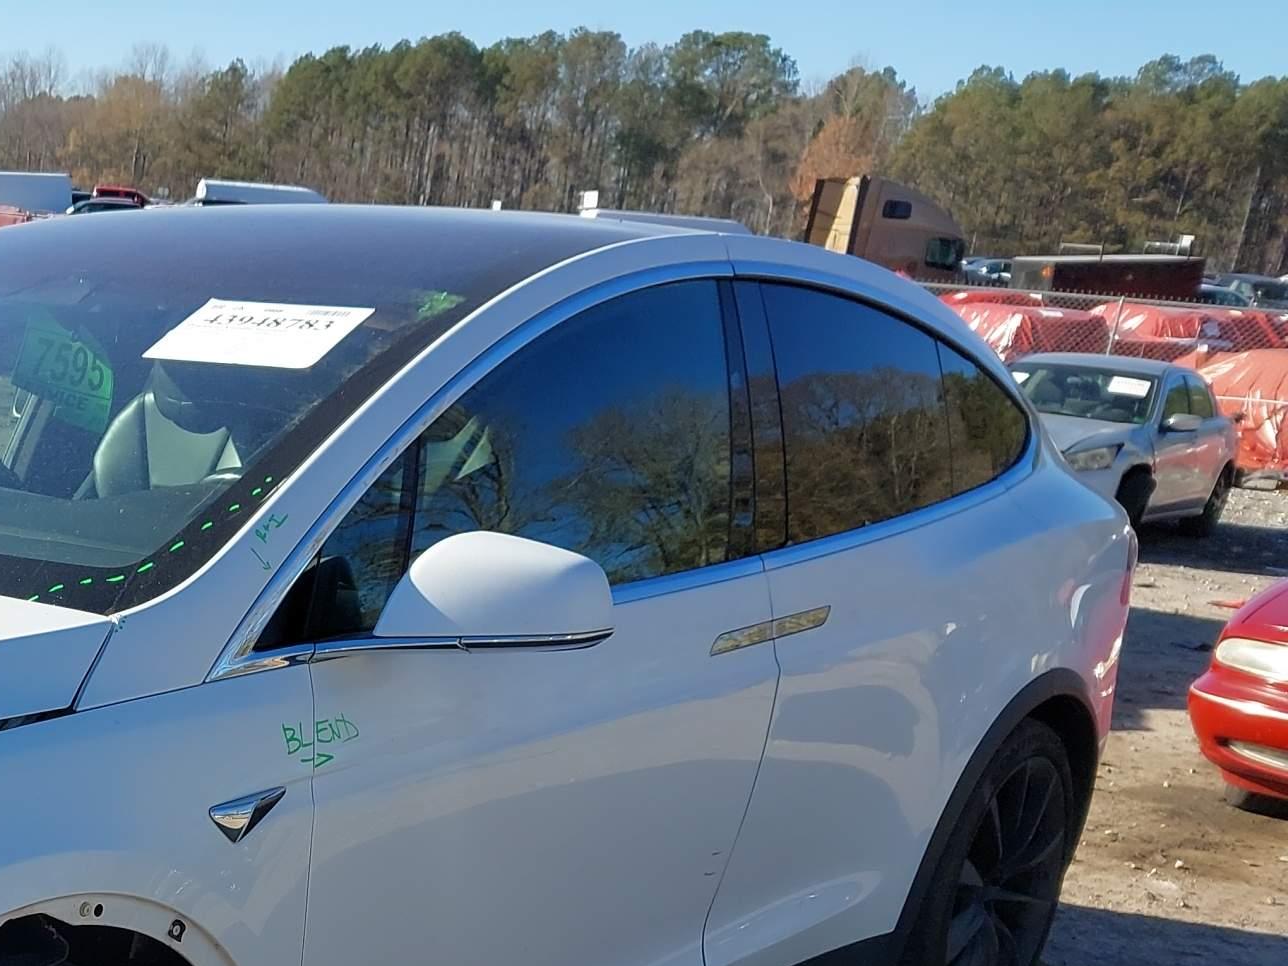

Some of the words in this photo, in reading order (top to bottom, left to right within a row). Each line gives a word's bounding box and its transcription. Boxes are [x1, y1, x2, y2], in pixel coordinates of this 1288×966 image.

[203, 314, 334, 331] 43948783
[33, 337, 104, 391] 7595
[282, 712, 359, 755] BLEND
